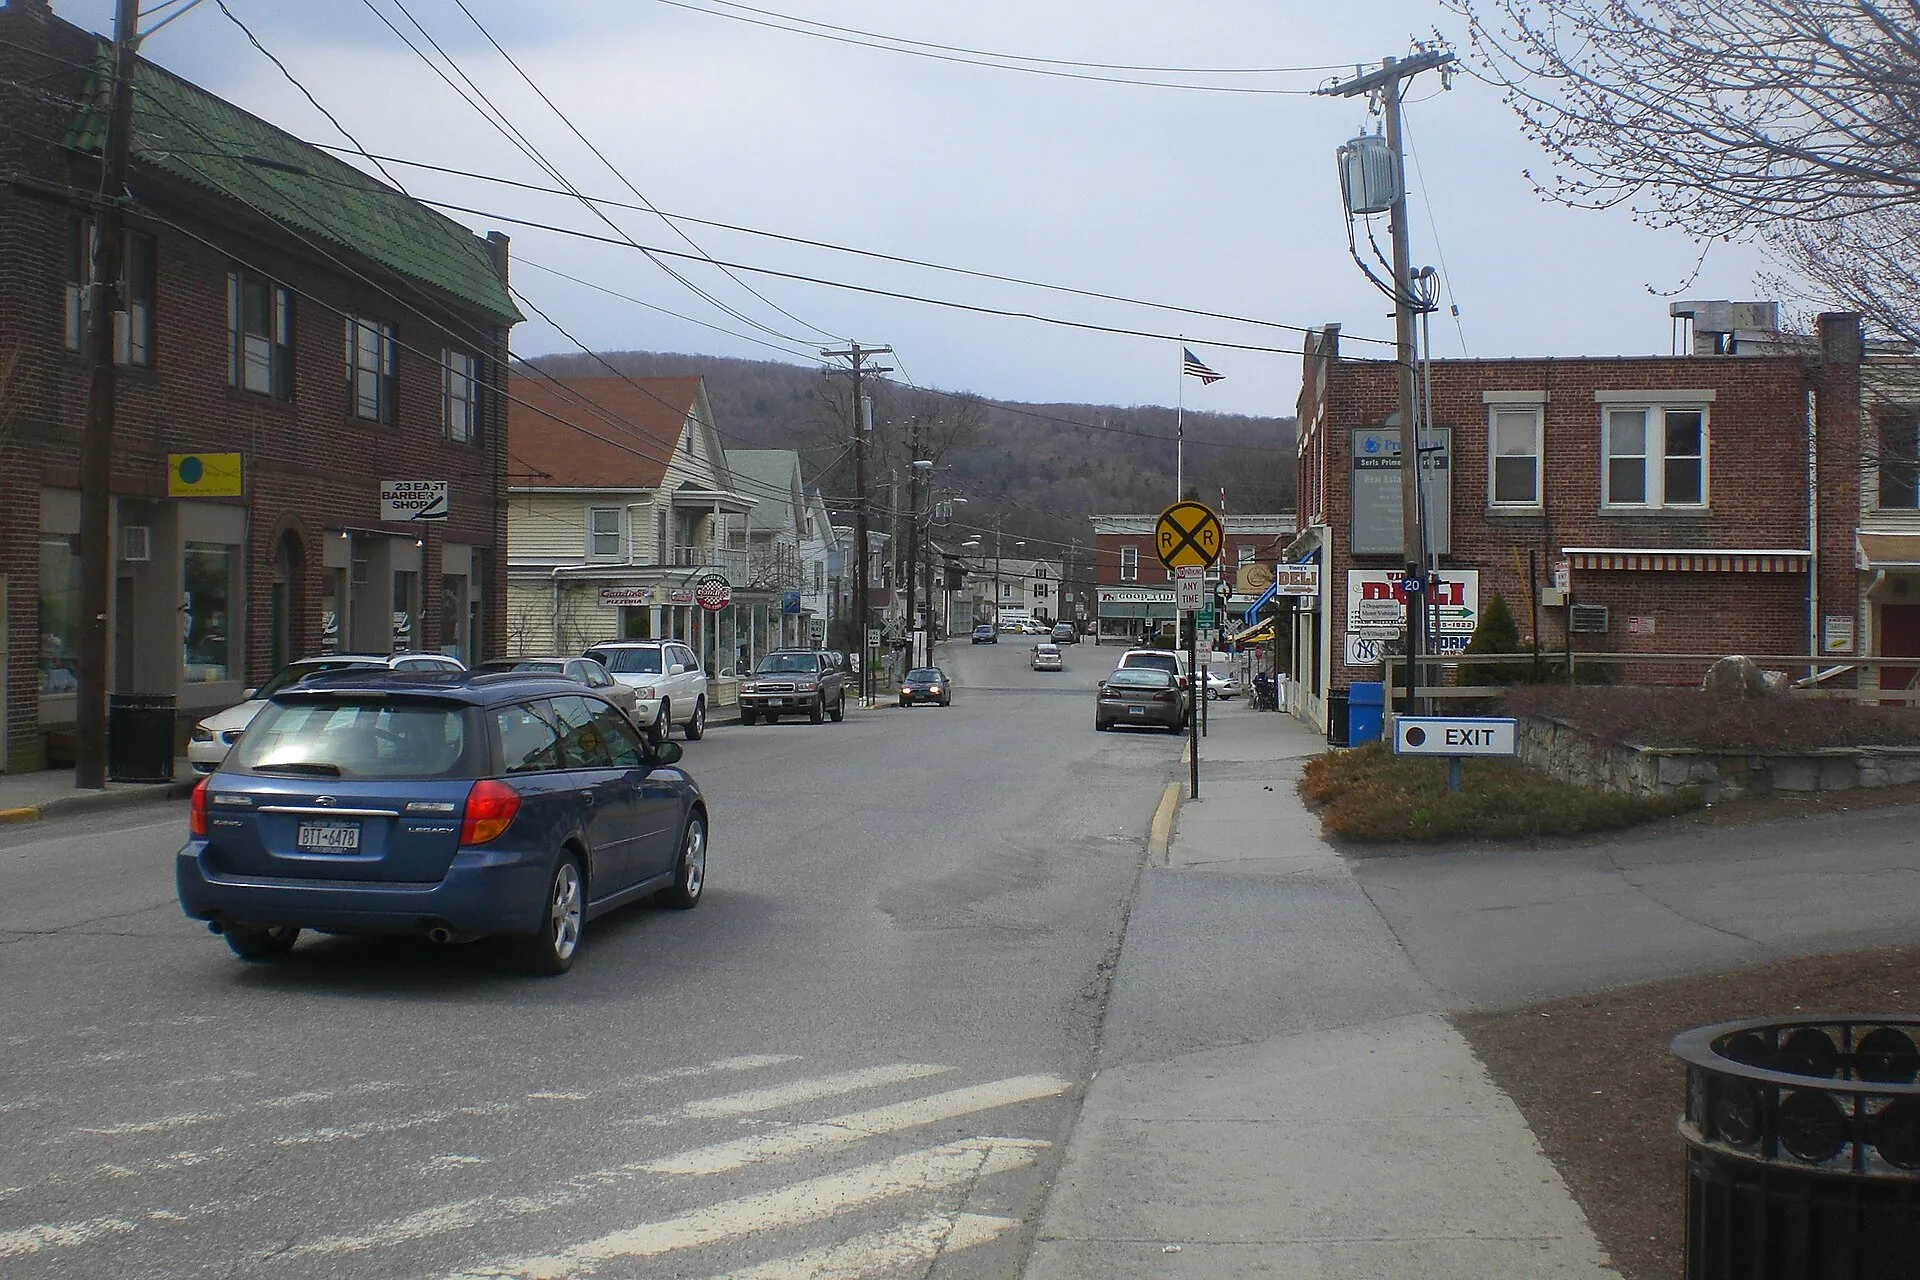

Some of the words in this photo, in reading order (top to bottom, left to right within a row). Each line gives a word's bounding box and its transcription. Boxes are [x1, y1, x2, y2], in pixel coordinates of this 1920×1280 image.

[395, 483, 411, 491] 23
[414, 483, 446, 491] EAST
[382, 492, 435, 500] BARBER
[392, 501, 428, 509] SHOP
[1161, 532, 1172, 548] R
[1203, 530, 1213, 545] R
[1279, 572, 1317, 585] DELI
[1182, 582, 1198, 591] ANY
[1405, 580, 1420, 591] 20
[1182, 595, 1199, 604] TIME
[1446, 729, 1495, 745] EXIT
